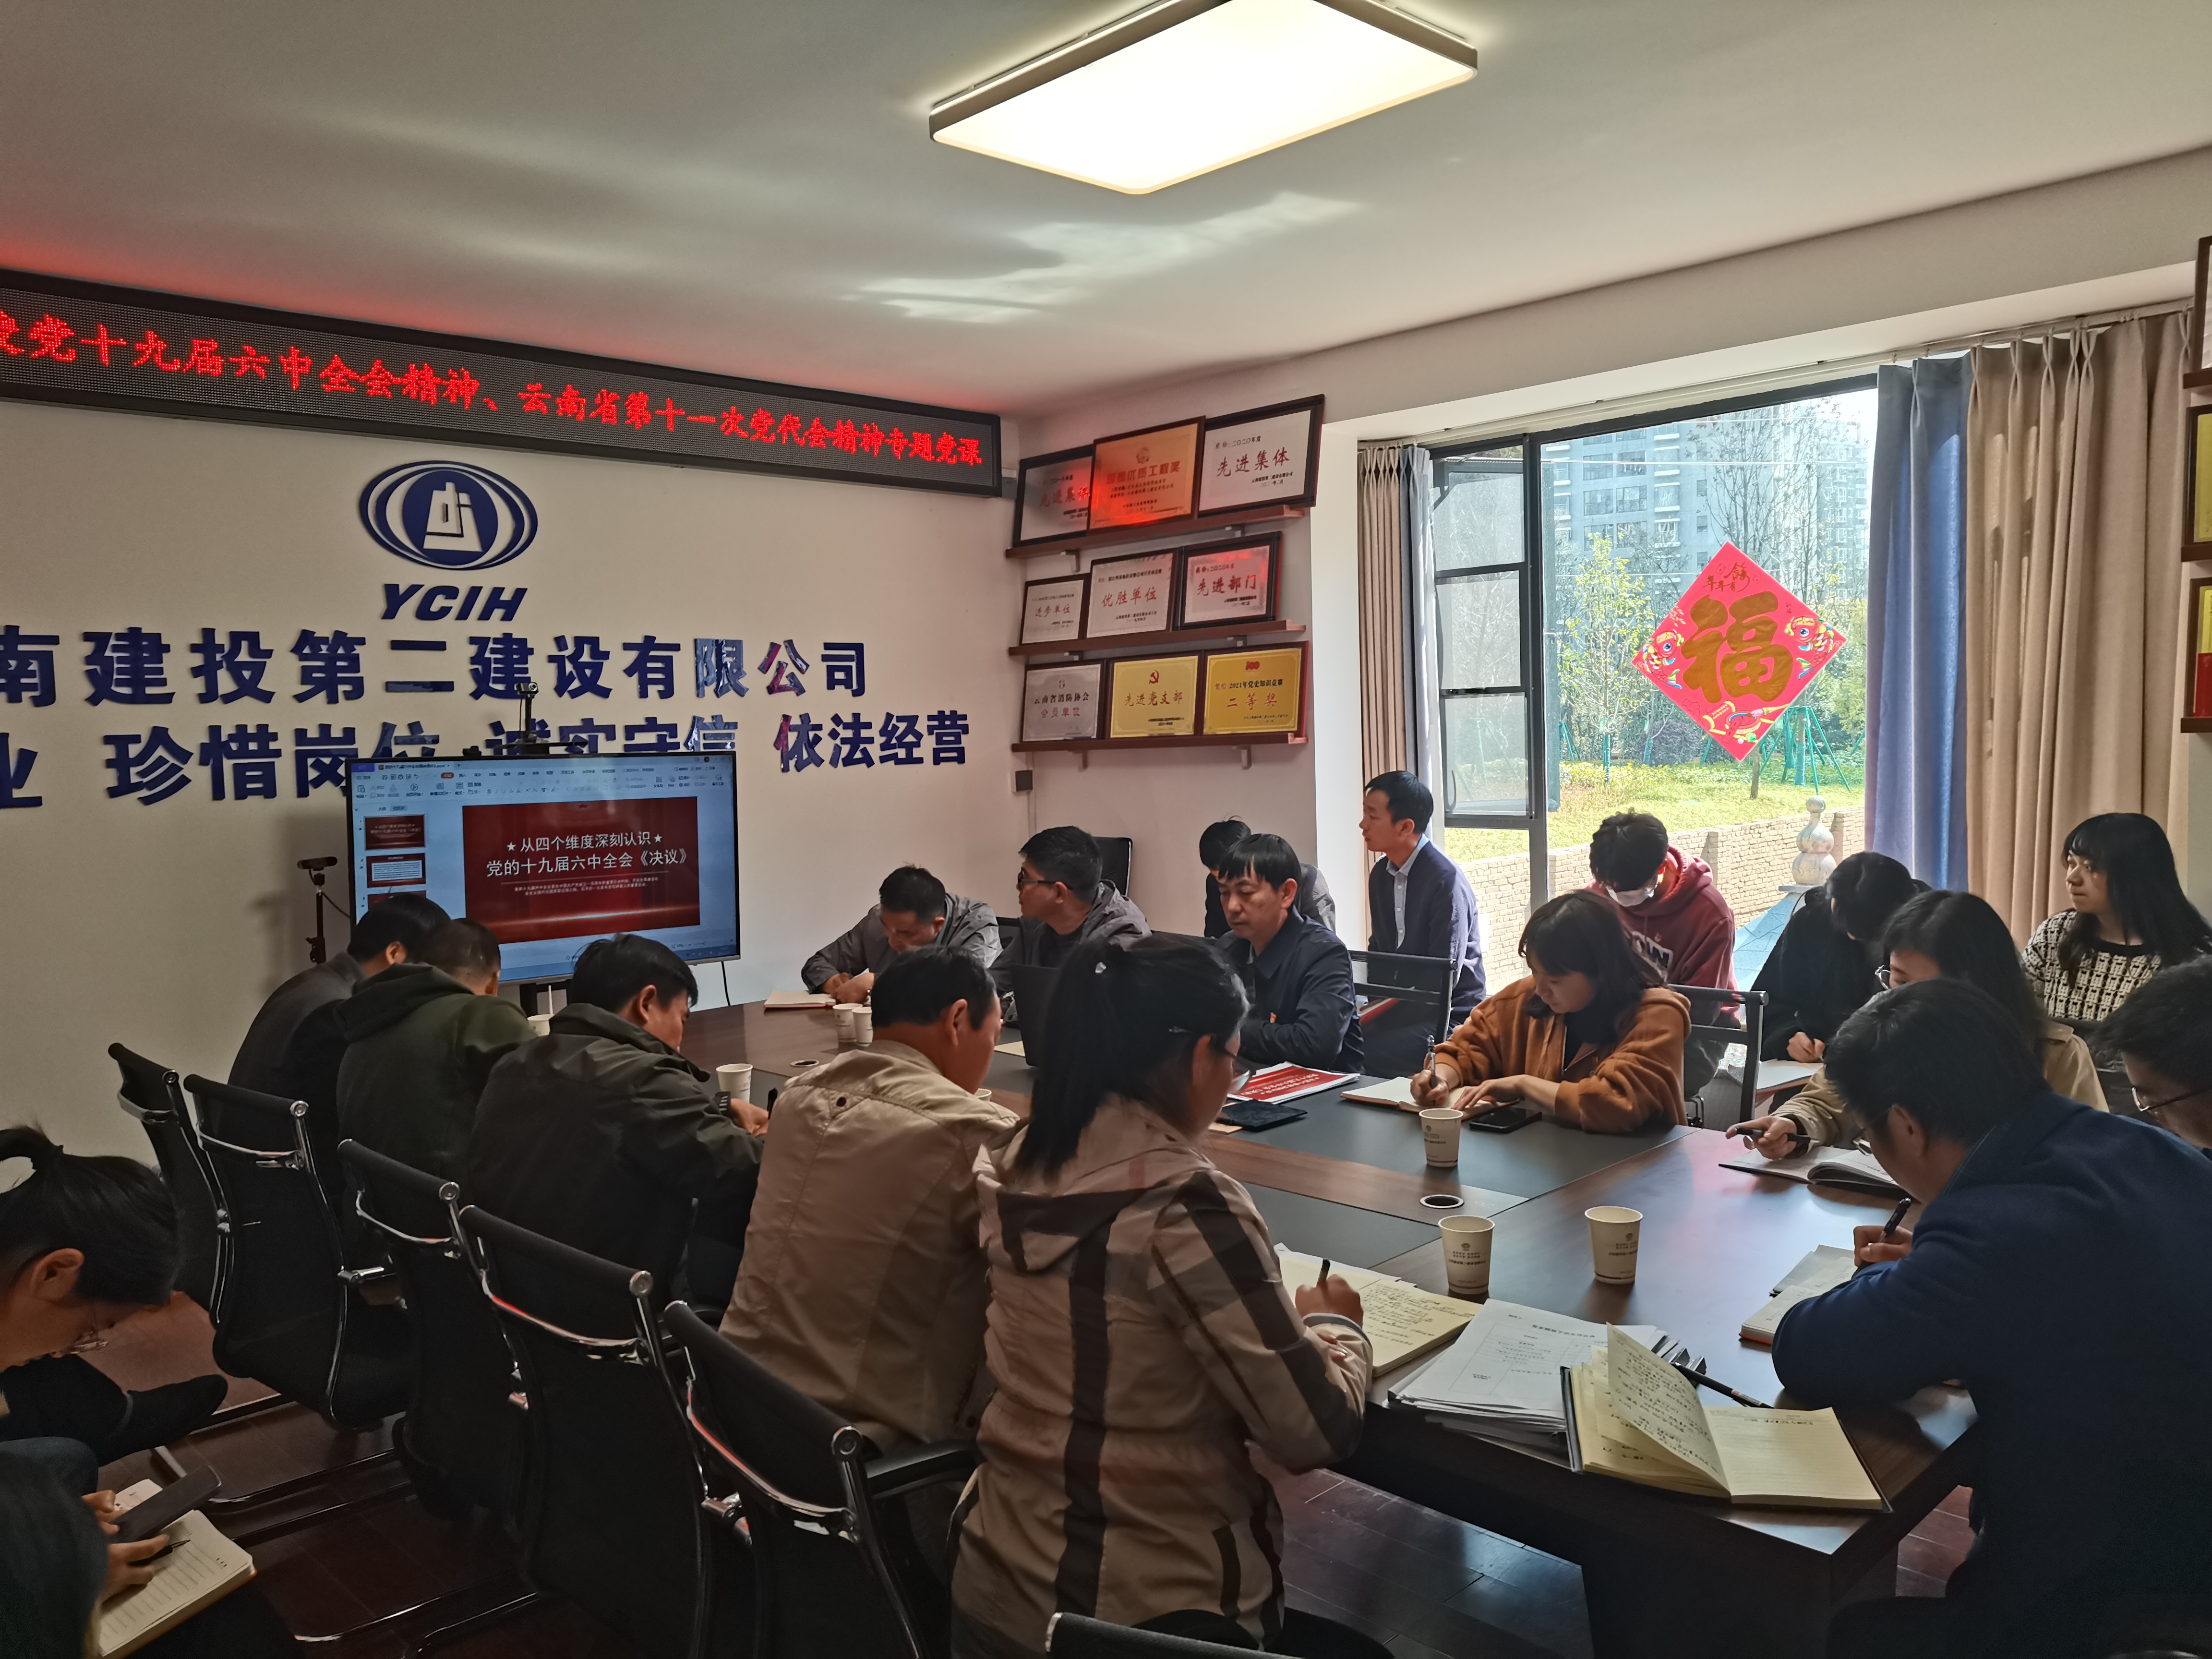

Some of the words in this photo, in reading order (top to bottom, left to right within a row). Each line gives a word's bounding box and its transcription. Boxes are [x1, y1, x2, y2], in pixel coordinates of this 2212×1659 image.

[1216, 447, 1290, 477] 先进集体
[1101, 586, 1156, 607] 优胜单位
[1196, 575, 1256, 596] 先进部门
[382, 584, 528, 621] YCIH
[1681, 591, 1793, 703] 福
[1034, 692, 1089, 704] 云南省消防协会
[1125, 690, 1183, 707] 先进党支部
[1226, 692, 1277, 710] 二等奖
[773, 710, 969, 772] 依法经营
[520, 831, 651, 853] 从四个维度深刻认识
[486, 848, 687, 877] 党的十九届六中全会《决议》
